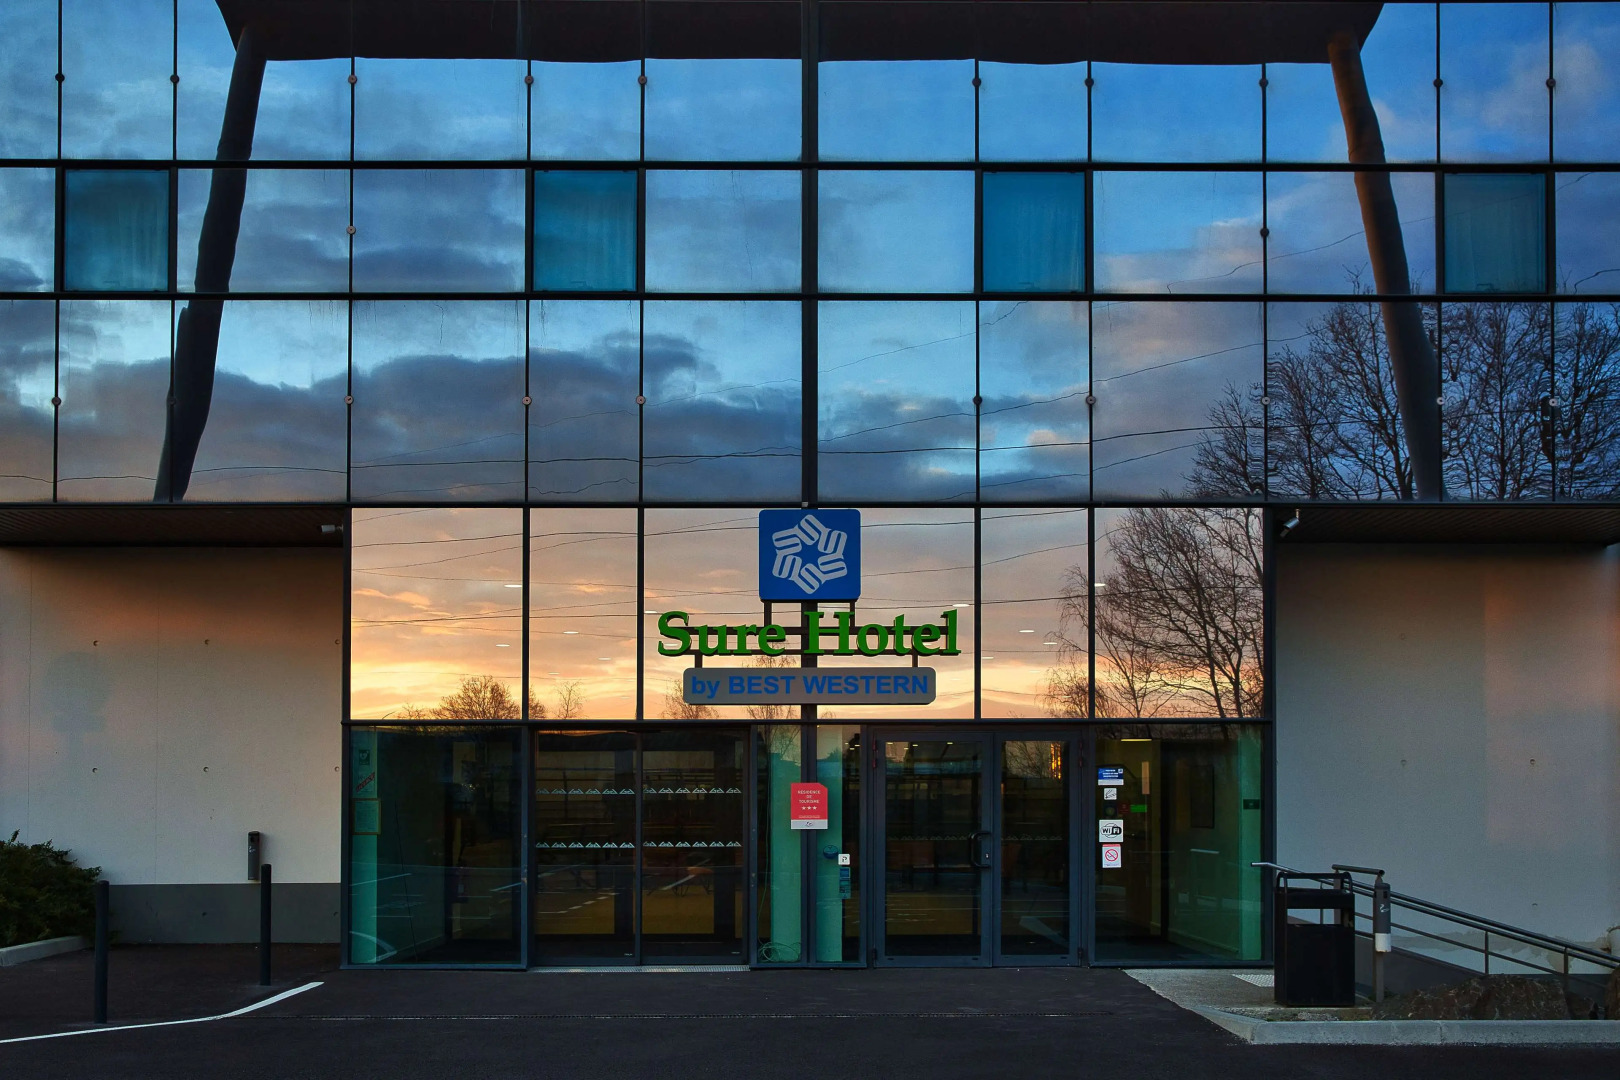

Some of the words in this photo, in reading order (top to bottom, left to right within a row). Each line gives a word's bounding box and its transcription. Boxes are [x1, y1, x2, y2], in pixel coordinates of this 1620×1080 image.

[658, 610, 786, 656] Sure
[804, 609, 962, 657] Hotel
[691, 676, 720, 699] by
[728, 676, 795, 694] BEST
[802, 676, 928, 694] WESTERN
